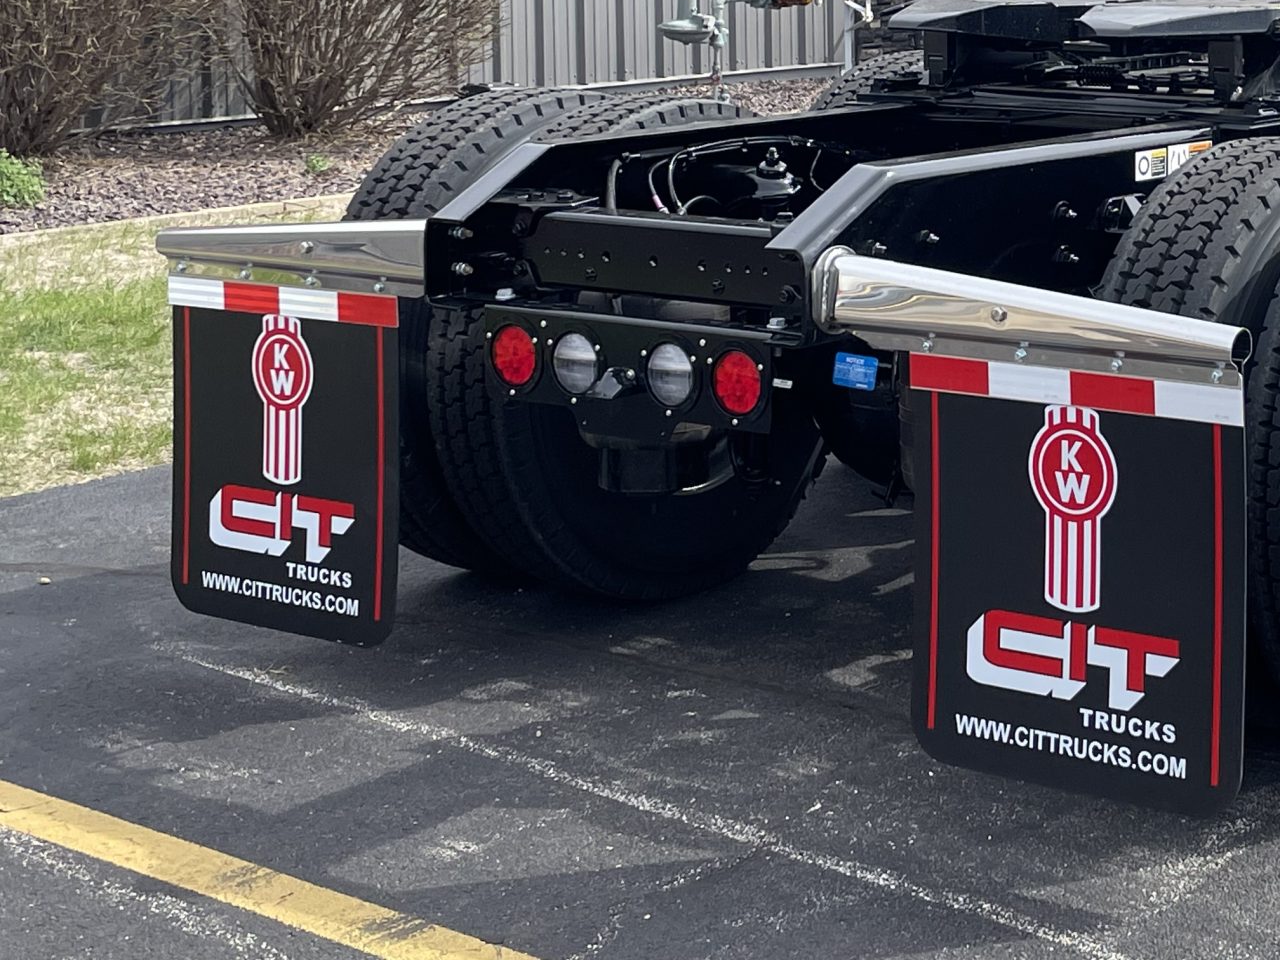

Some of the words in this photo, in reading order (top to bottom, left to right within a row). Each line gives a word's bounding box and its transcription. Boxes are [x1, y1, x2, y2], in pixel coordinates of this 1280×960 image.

[209, 484, 356, 564] CIT
[202, 570, 359, 617] WWW.CITTRUCKS.COM
[286, 562, 352, 588] TRUCKS
[966, 609, 1181, 711] CIT
[955, 713, 1187, 780] WWW.CITTRUCKS.COM
[1079, 707, 1176, 744] TRUCKS
